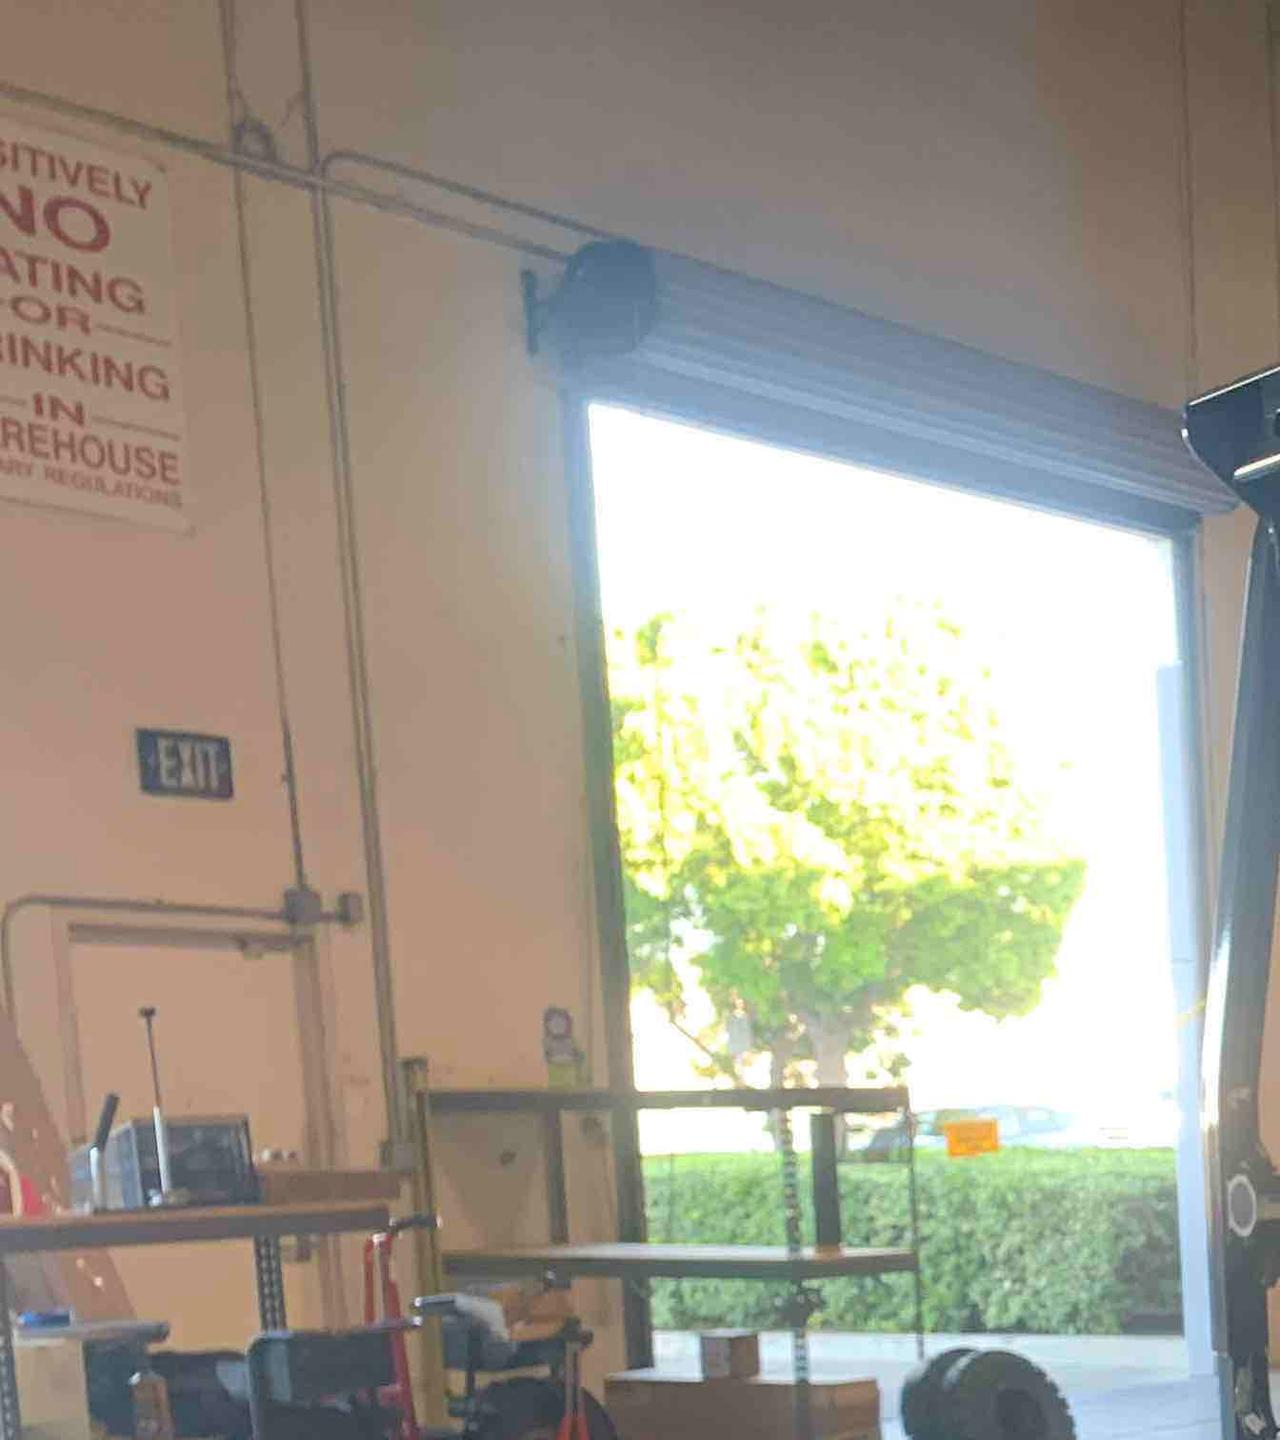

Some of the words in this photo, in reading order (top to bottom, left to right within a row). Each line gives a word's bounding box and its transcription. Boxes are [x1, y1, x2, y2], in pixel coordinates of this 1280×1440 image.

[11, 295, 91, 335] OR
[0, 332, 170, 401] INKING
[33, 393, 84, 426] IN
[0, 416, 181, 486] REHOUSE
[158, 737, 220, 791] EXIT
